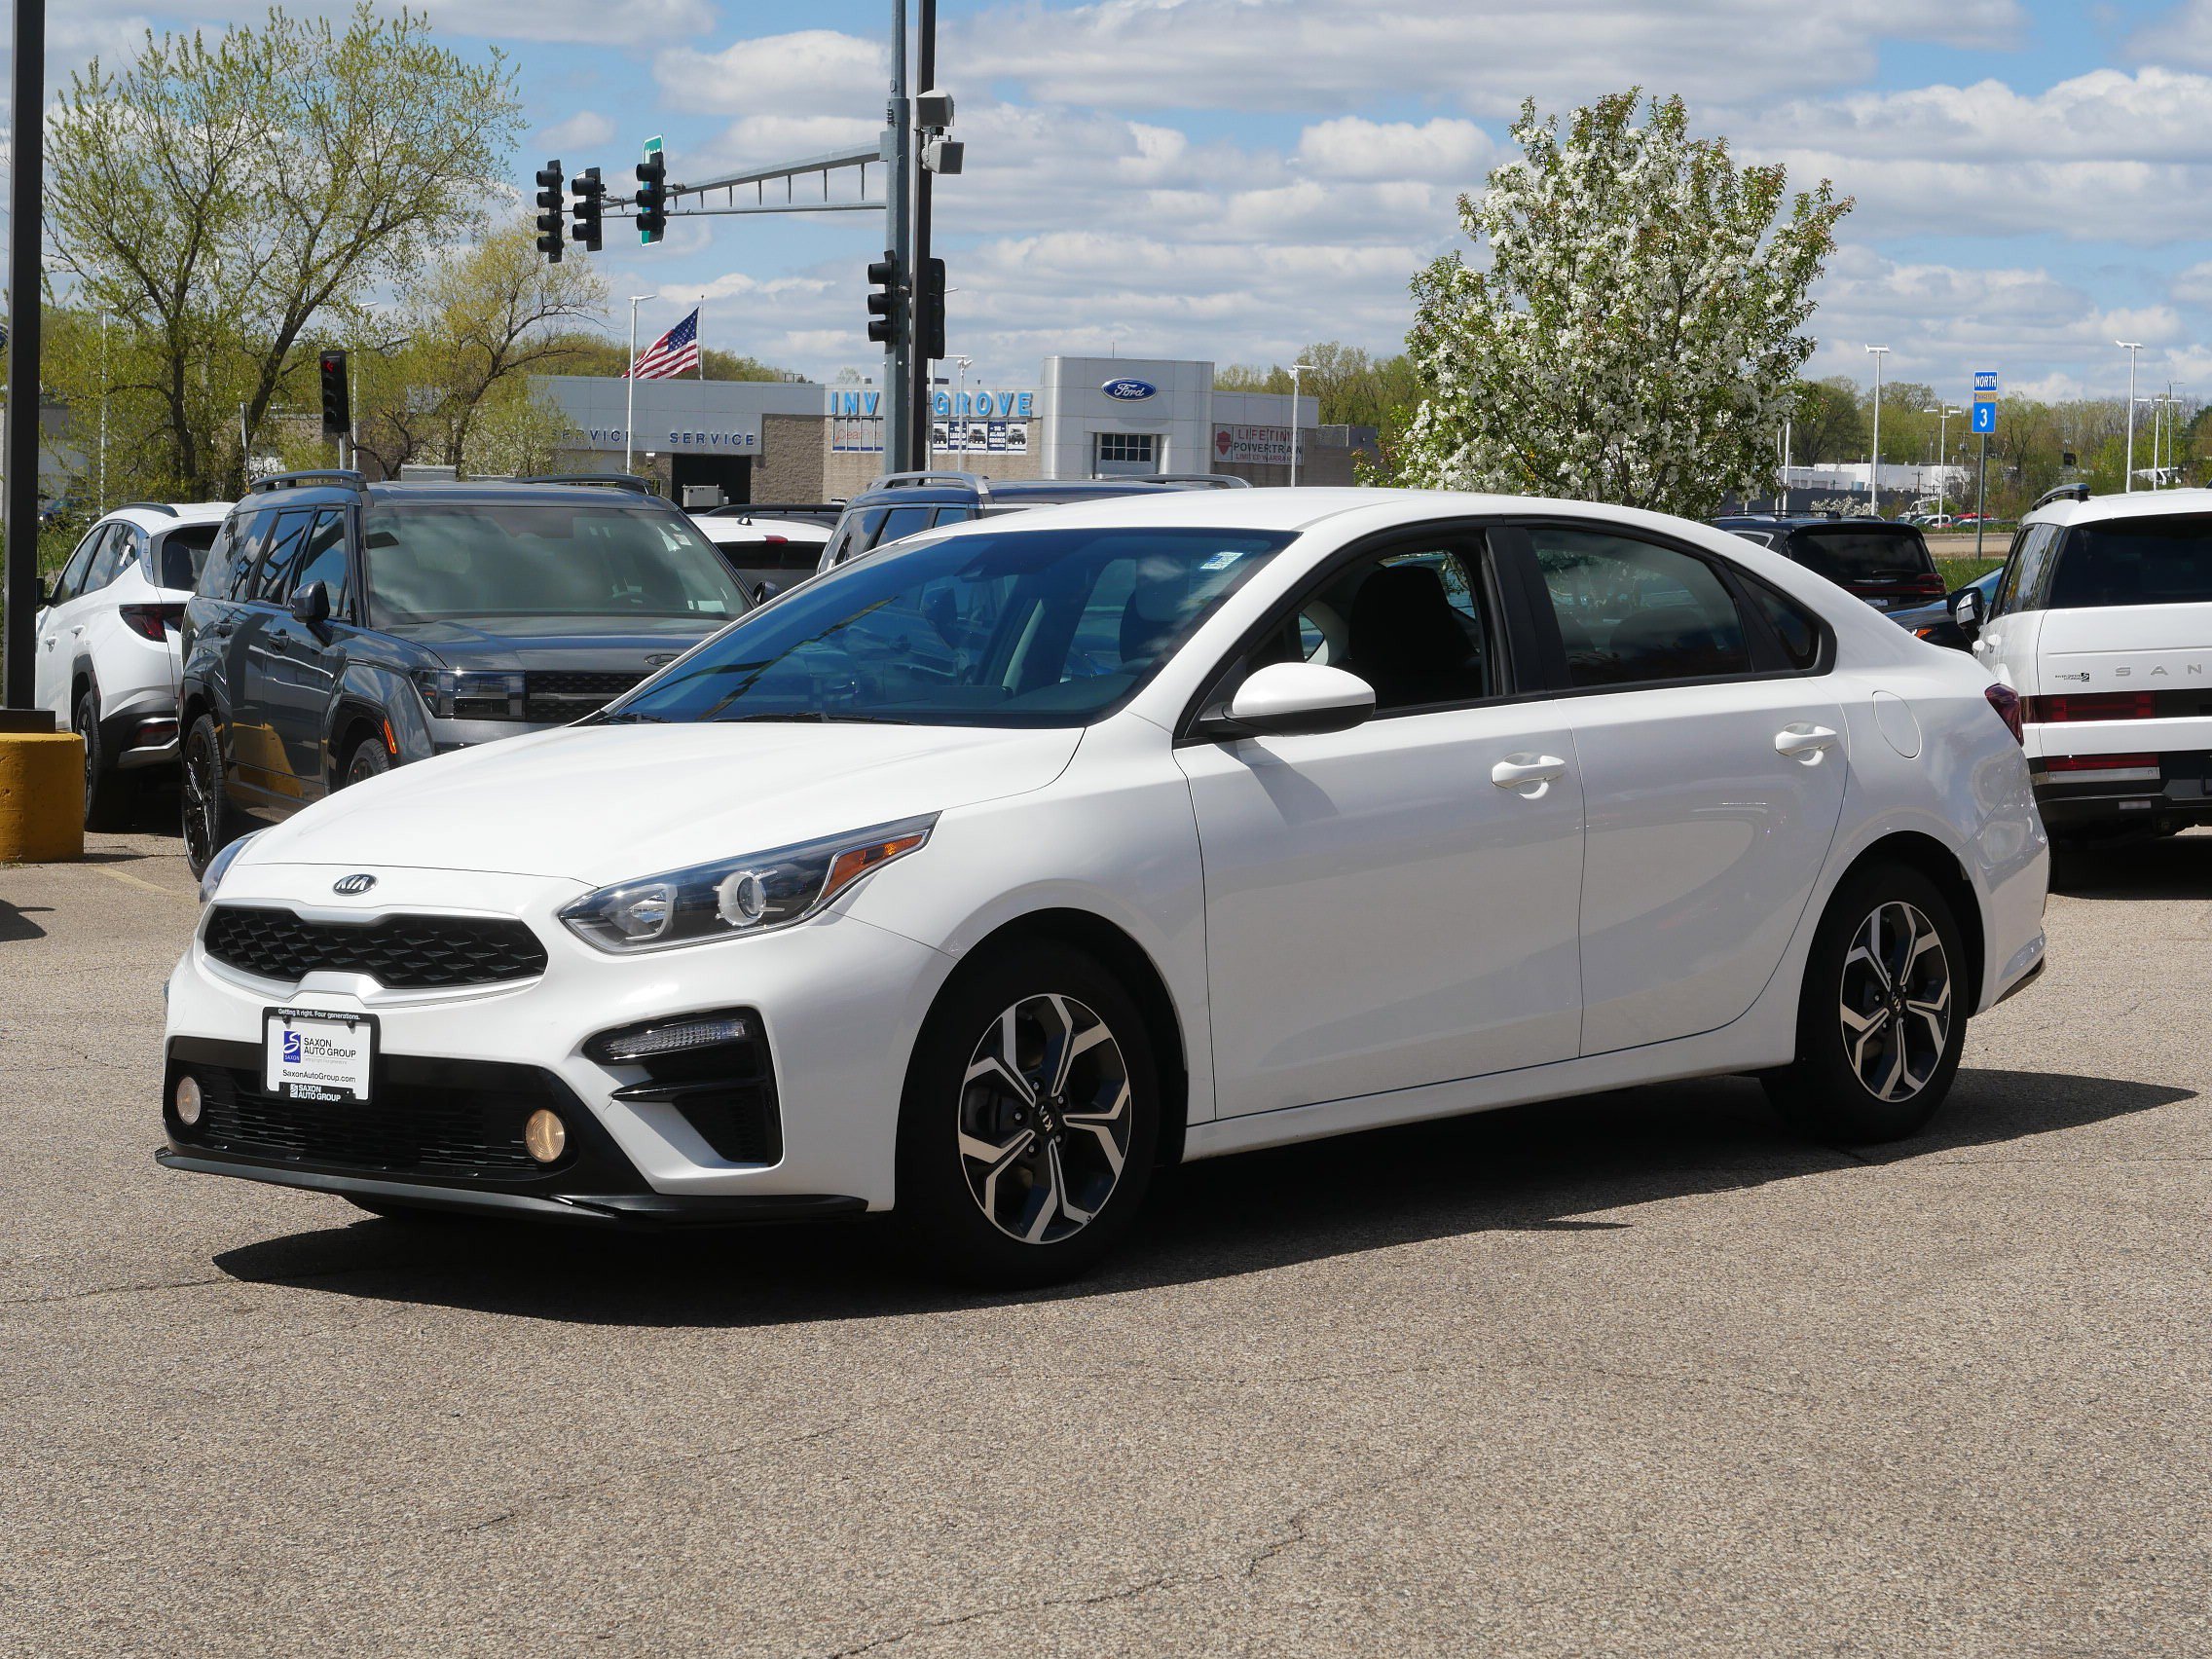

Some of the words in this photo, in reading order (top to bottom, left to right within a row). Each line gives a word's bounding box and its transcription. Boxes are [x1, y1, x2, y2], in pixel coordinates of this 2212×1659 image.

[1975, 376, 1997, 387] NORTH
[1115, 384, 1145, 396] Ford
[830, 391, 880, 415] INV
[934, 391, 1032, 416] GROVE
[1979, 409, 1988, 427] 3
[670, 432, 755, 446] SERVICE
[2115, 664, 2202, 678] SAN
[335, 875, 369, 890] KIA
[277, 1008, 296, 1016] Getting
[300, 1010, 314, 1018] right.
[304, 1037, 332, 1048] SAXON
[303, 1047, 326, 1055] AUTO
[326, 1048, 356, 1058] GROUP
[282, 1069, 356, 1083] SaxonAutoGroup.com
[298, 1084, 322, 1093] SAXON
[298, 1090, 315, 1100] AUTO
[316, 1092, 342, 1102] GROUP
